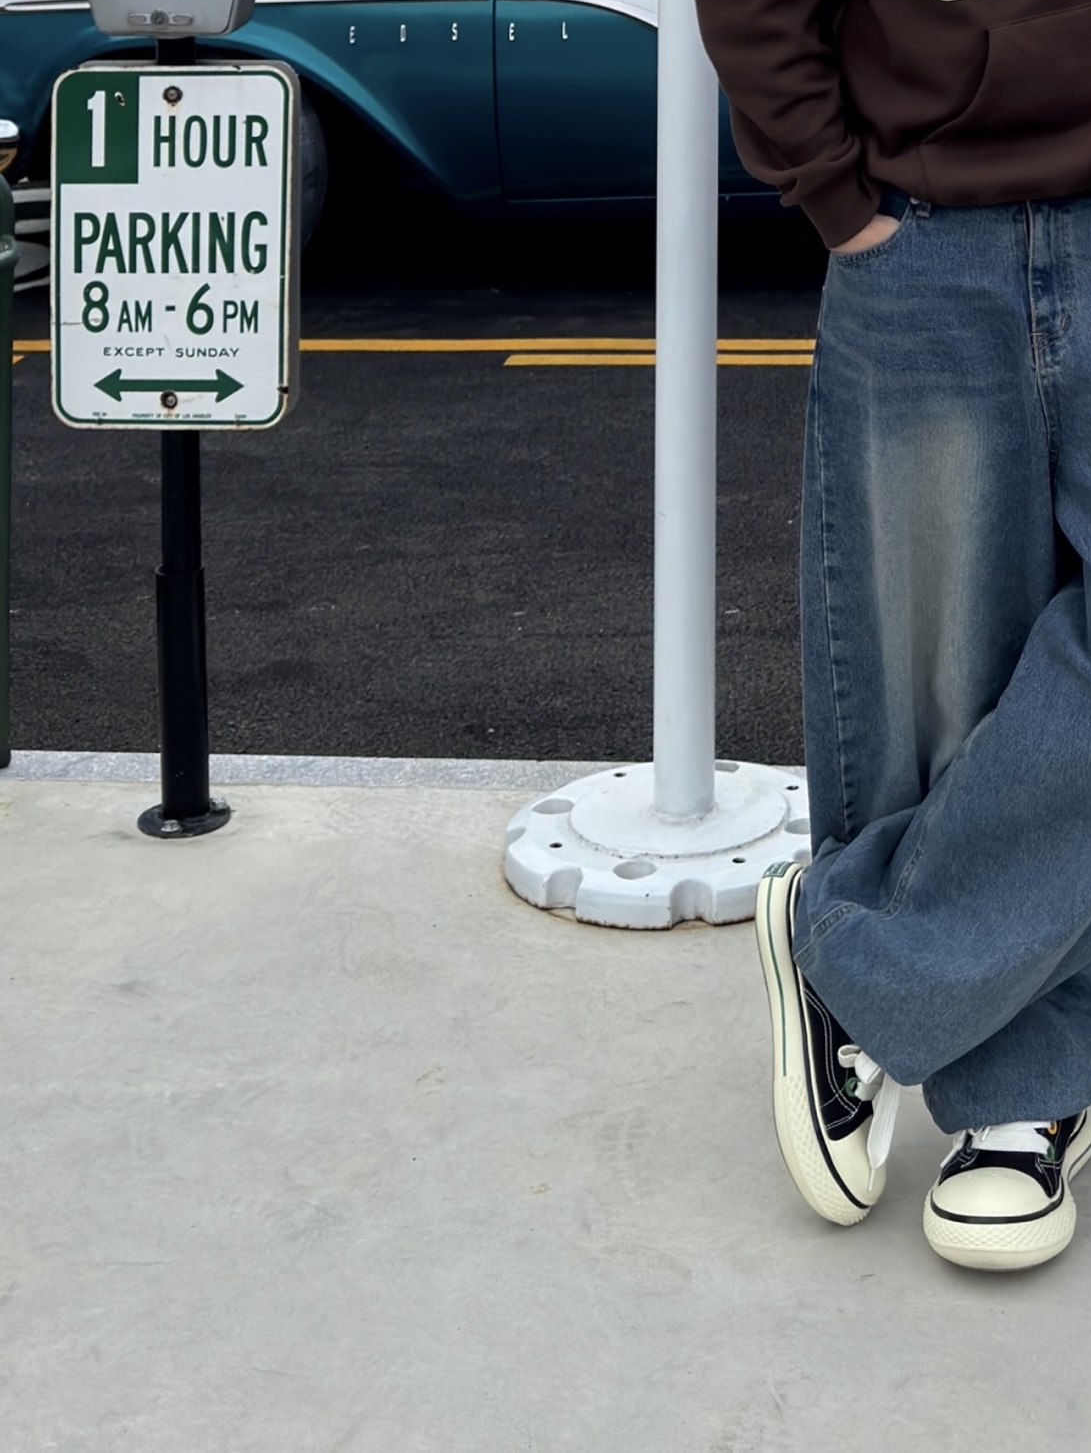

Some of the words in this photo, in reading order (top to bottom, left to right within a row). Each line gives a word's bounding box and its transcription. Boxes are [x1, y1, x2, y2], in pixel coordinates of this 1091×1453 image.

[86, 90, 106, 168] 1
[153, 114, 269, 168] HOUR
[73, 211, 268, 274] PARKING
[103, 347, 164, 358] EXCEPT
[175, 347, 240, 358] SUNDAY
